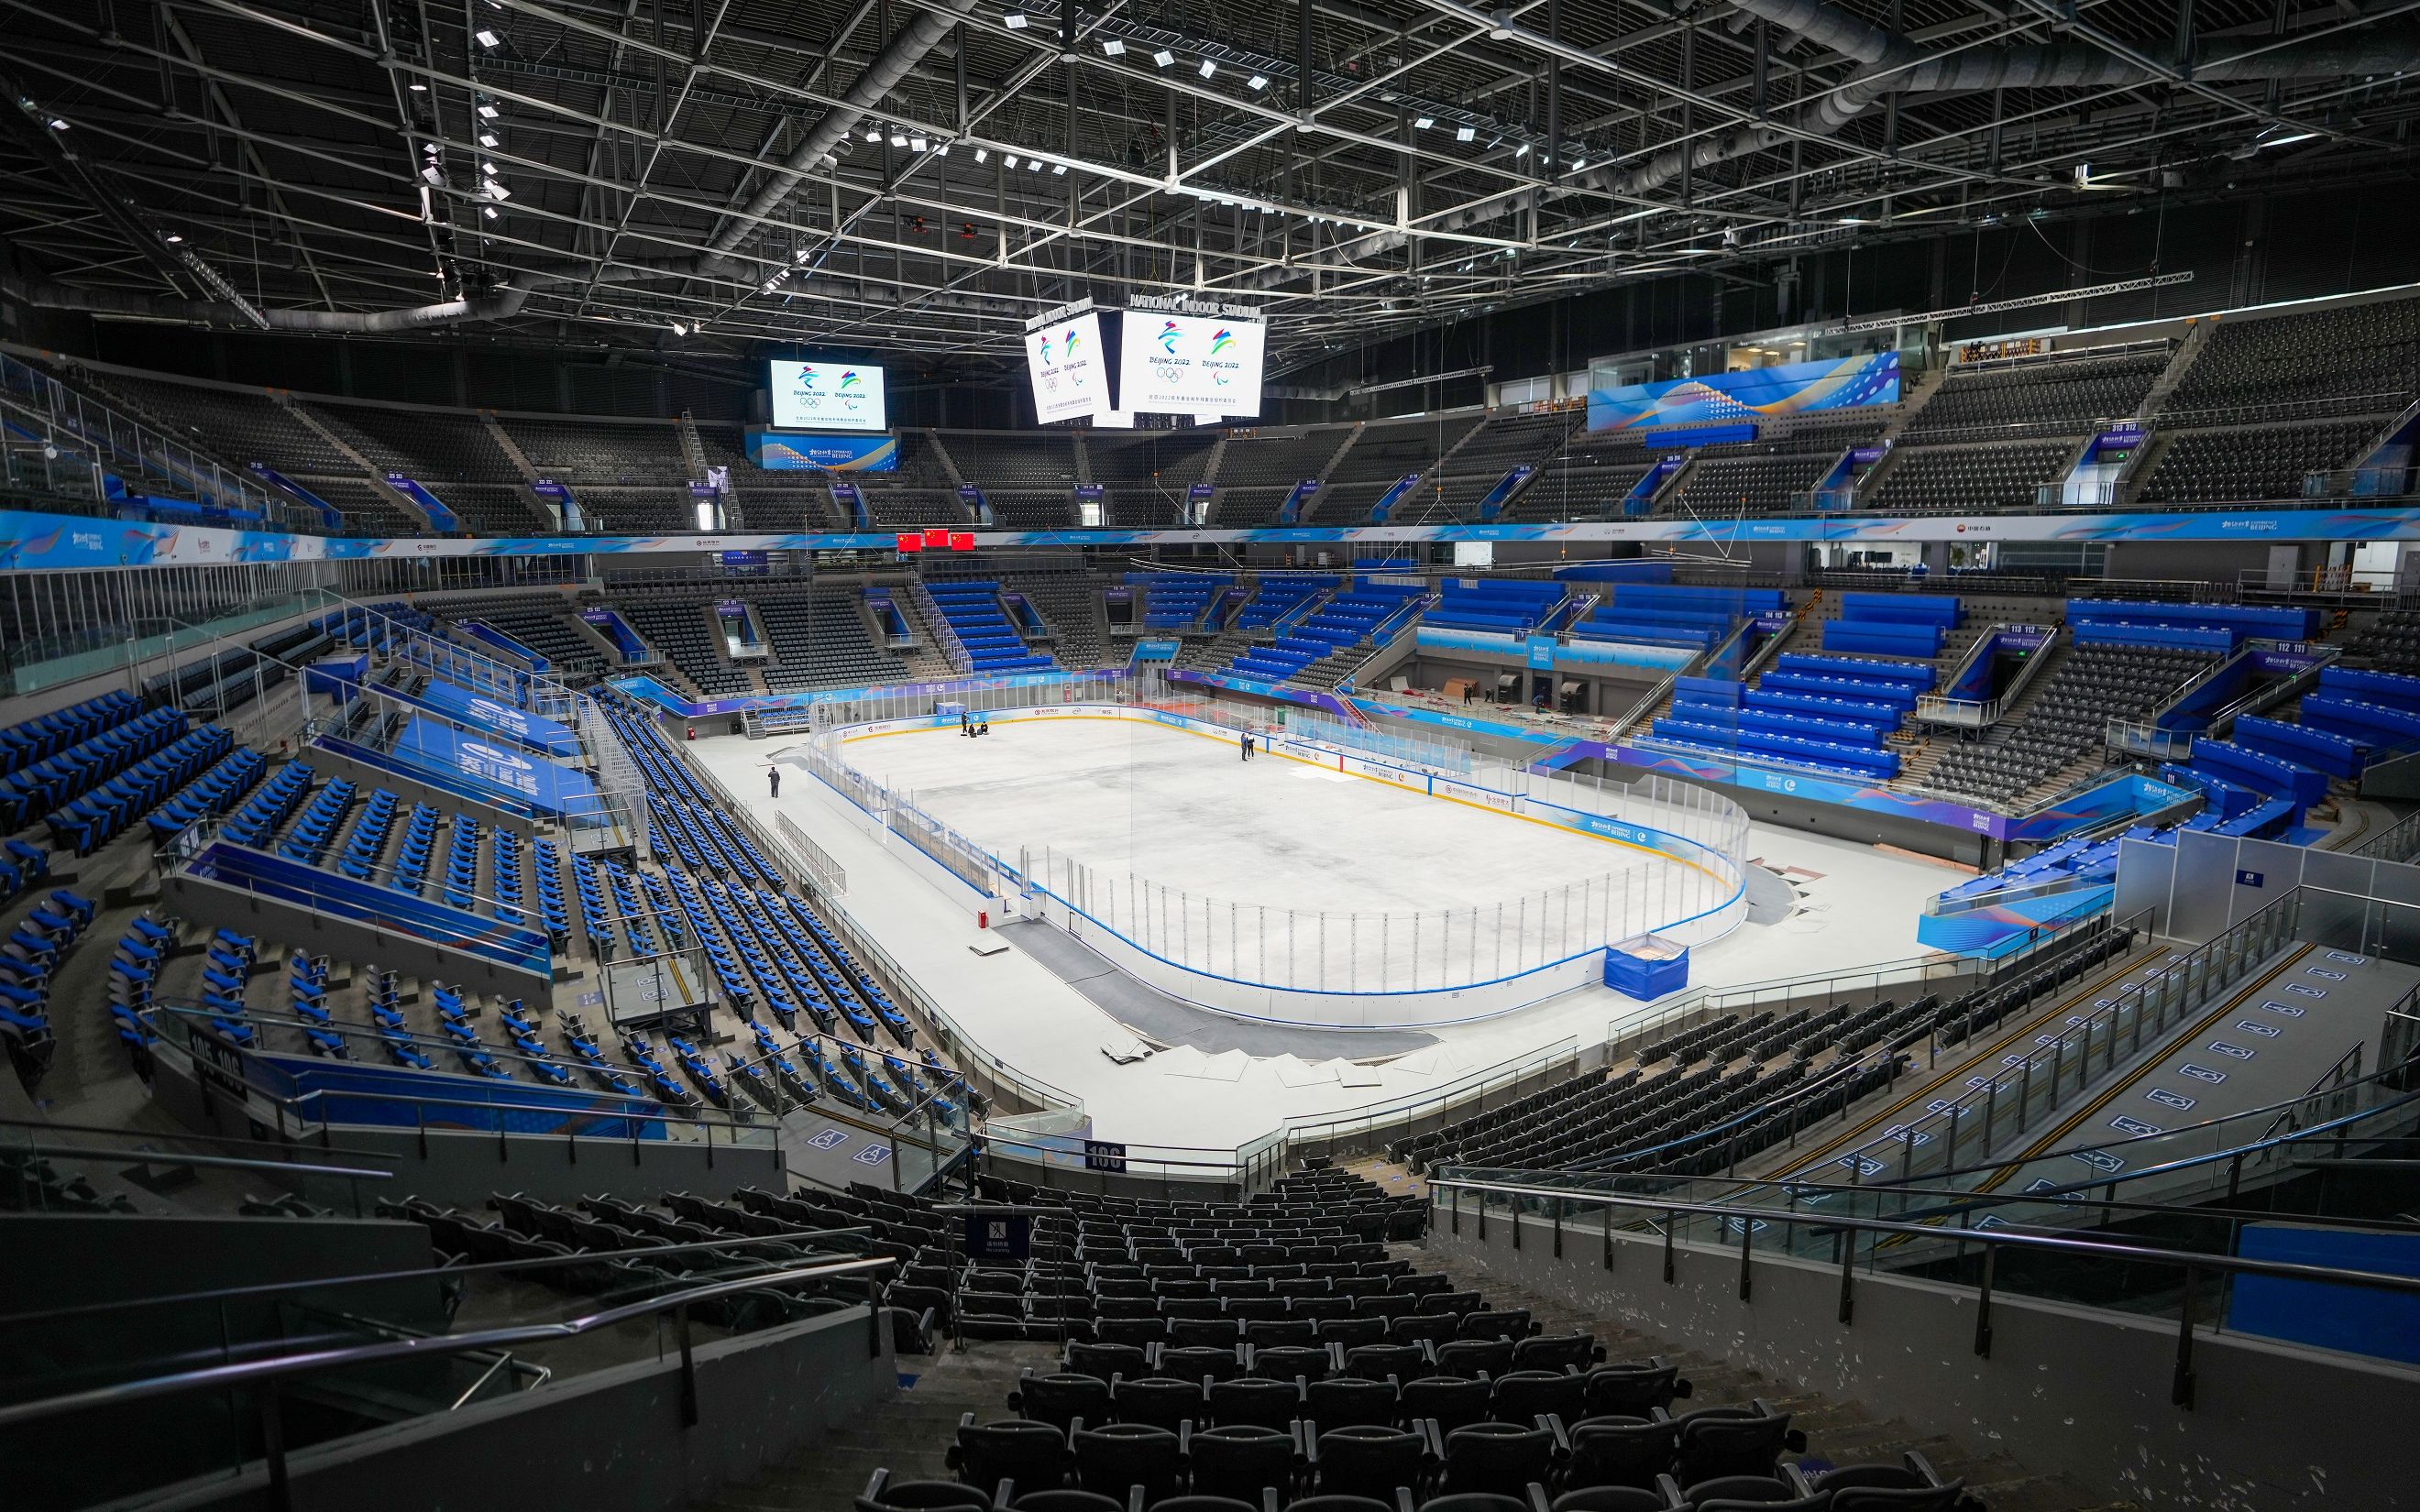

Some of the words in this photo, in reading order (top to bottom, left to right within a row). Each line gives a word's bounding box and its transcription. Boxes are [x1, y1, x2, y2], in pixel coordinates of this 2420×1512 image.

[1129, 293, 1179, 311] NATIONAL
[1182, 300, 1219, 314] INDOOR
[1222, 303, 1261, 318] STADIUM
[1149, 356, 1172, 366] BEIJING
[1202, 360, 1223, 369] BEIJING
[2011, 625, 2021, 633] 113
[2278, 642, 2290, 652] 112
[2294, 643, 2305, 653] 111
[2167, 773, 2175, 784] 111
[1611, 829, 1631, 839] BEIJING
[192, 1034, 215, 1077] 105
[217, 1048, 243, 1091] 106
